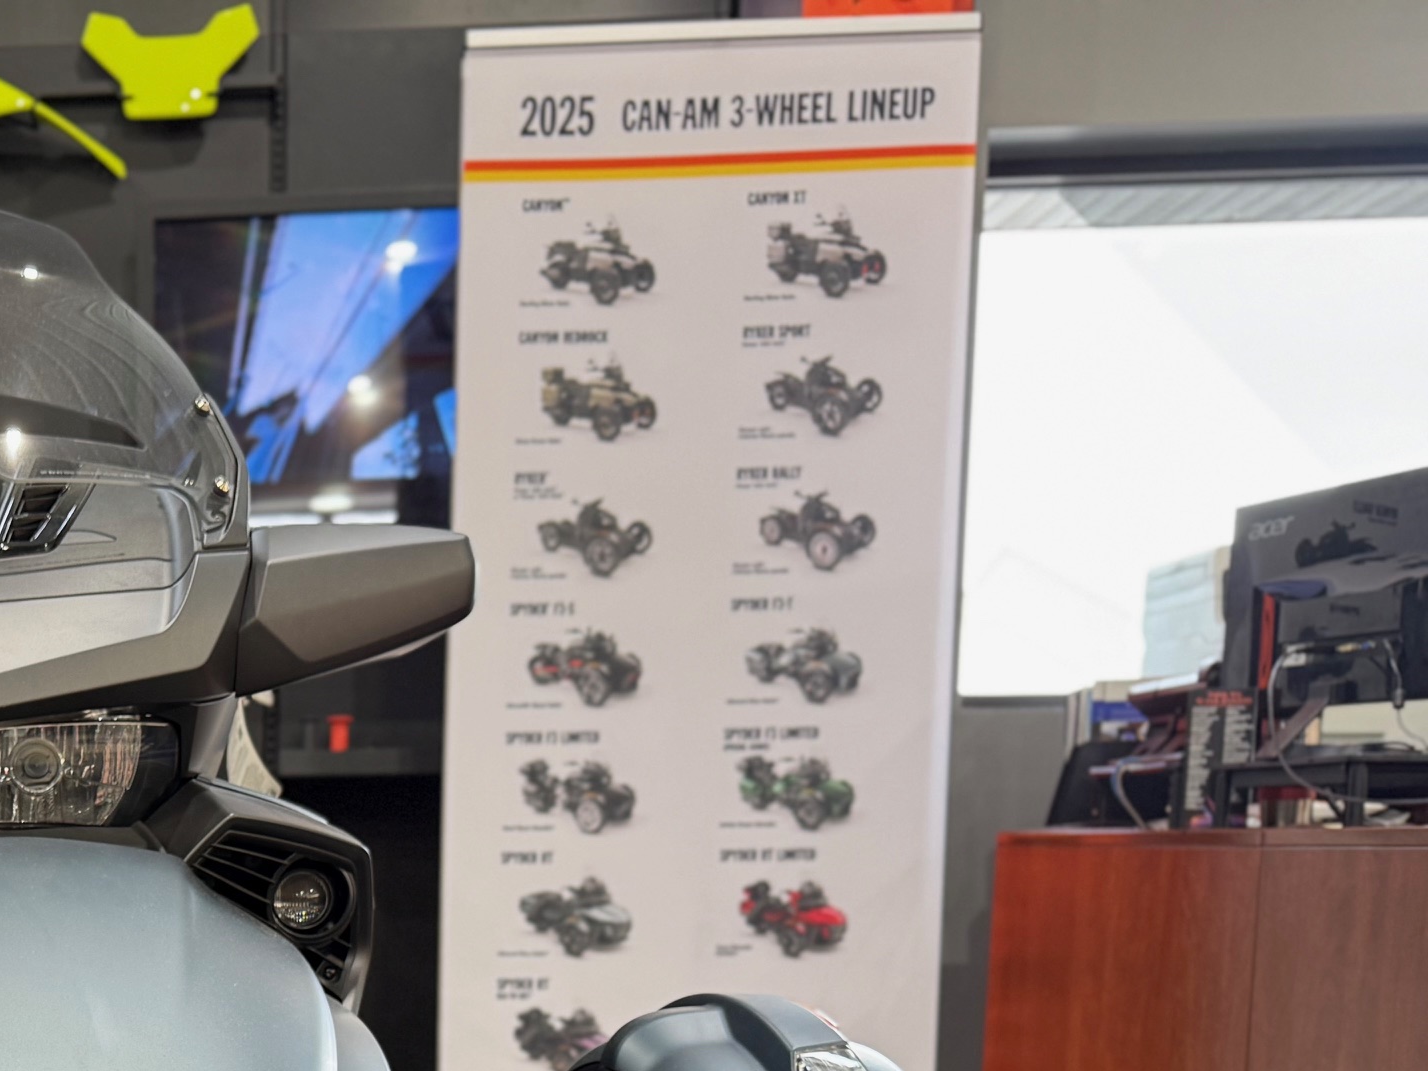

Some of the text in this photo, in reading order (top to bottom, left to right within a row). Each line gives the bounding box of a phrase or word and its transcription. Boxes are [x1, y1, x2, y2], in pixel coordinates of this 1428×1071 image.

[520, 87, 936, 137] 2025 CAN-AM 3-WHEEL LINEUP
[1248, 516, 1295, 540] acer
